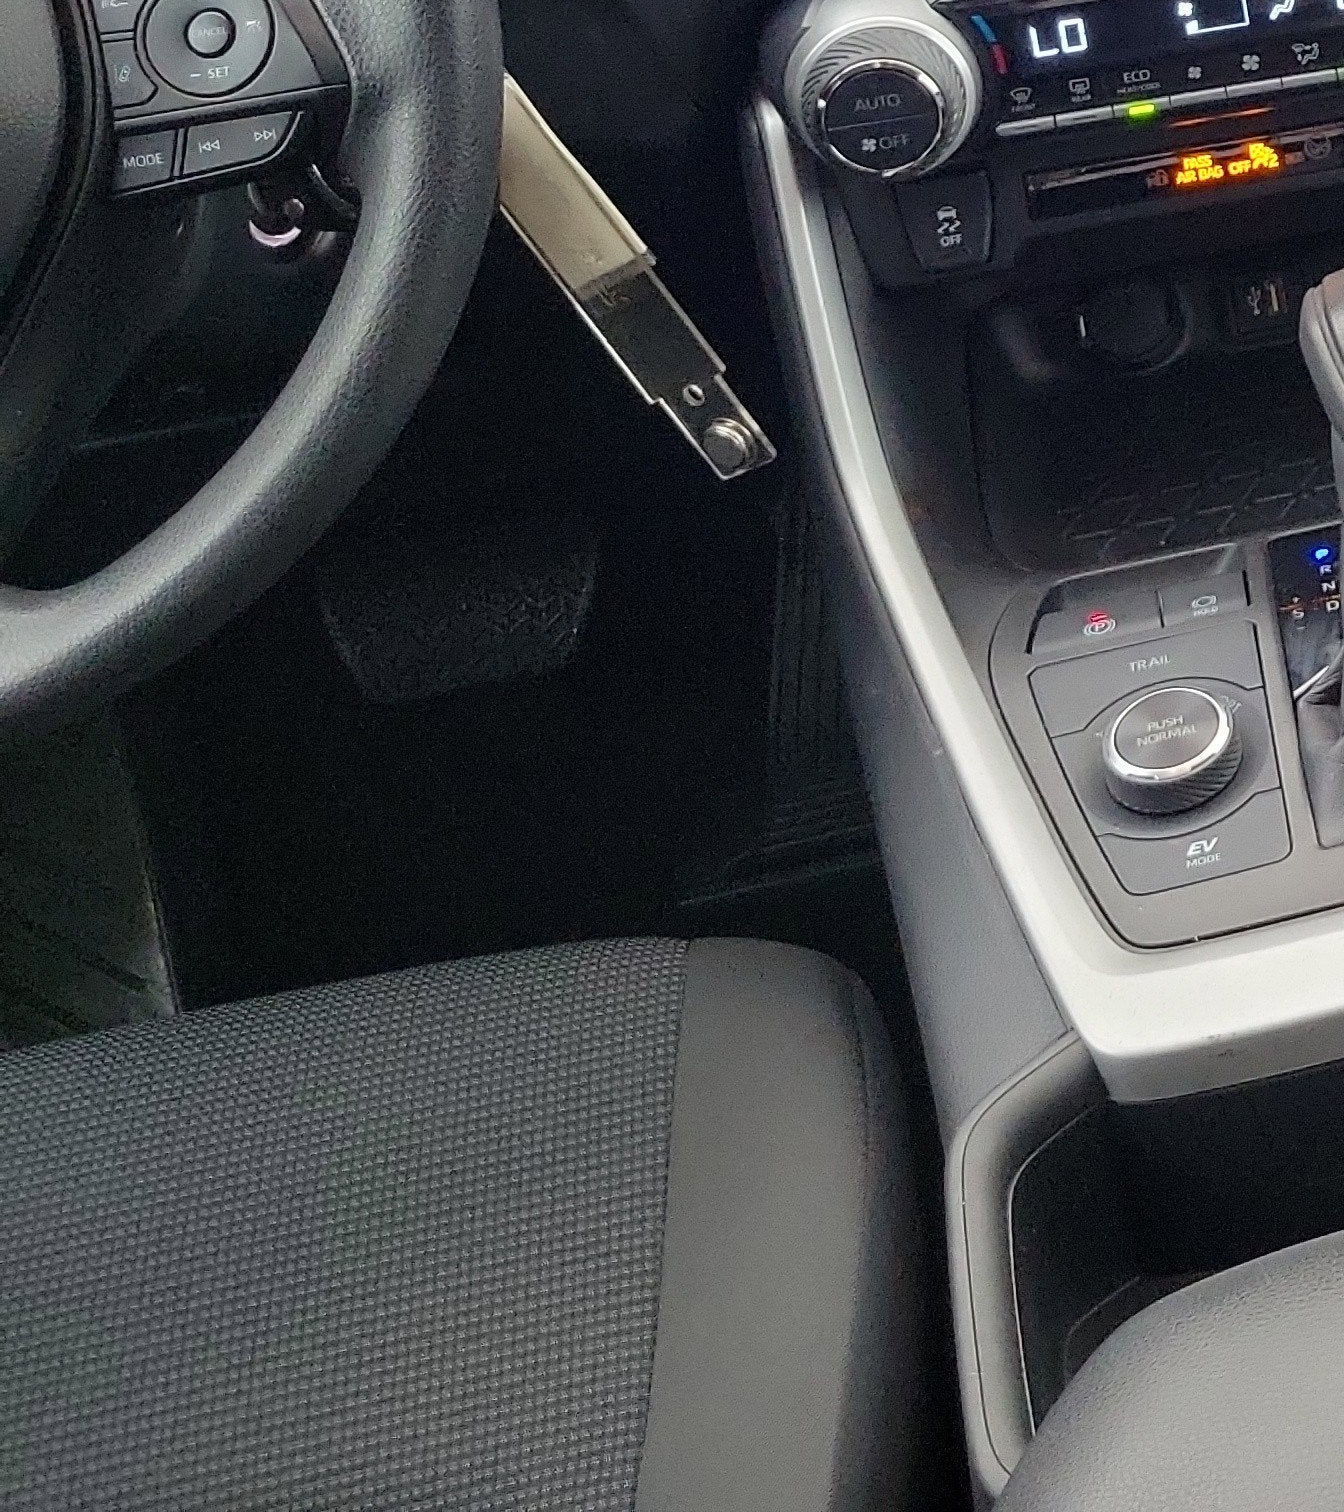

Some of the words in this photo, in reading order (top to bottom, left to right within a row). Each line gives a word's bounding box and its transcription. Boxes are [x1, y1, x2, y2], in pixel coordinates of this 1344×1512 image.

[1028, 17, 1088, 59] LO
[207, 66, 230, 79] SET
[1123, 69, 1151, 84] ECO
[854, 93, 901, 112] AUTO
[878, 134, 909, 150] OFF
[122, 153, 165, 168] MODE
[1183, 154, 1213, 171] PASS
[1176, 169, 1198, 185] AIR
[1198, 165, 1225, 181] BAG
[1228, 159, 1252, 175] OFF
[1321, 580, 1337, 593] N
[1325, 600, 1341, 613] D
[1128, 654, 1171, 672] TRAIL
[1147, 715, 1185, 731] PUSH
[1136, 724, 1198, 746] NORMAL
[1186, 836, 1219, 857] EV
[1186, 851, 1222, 869] MODE
